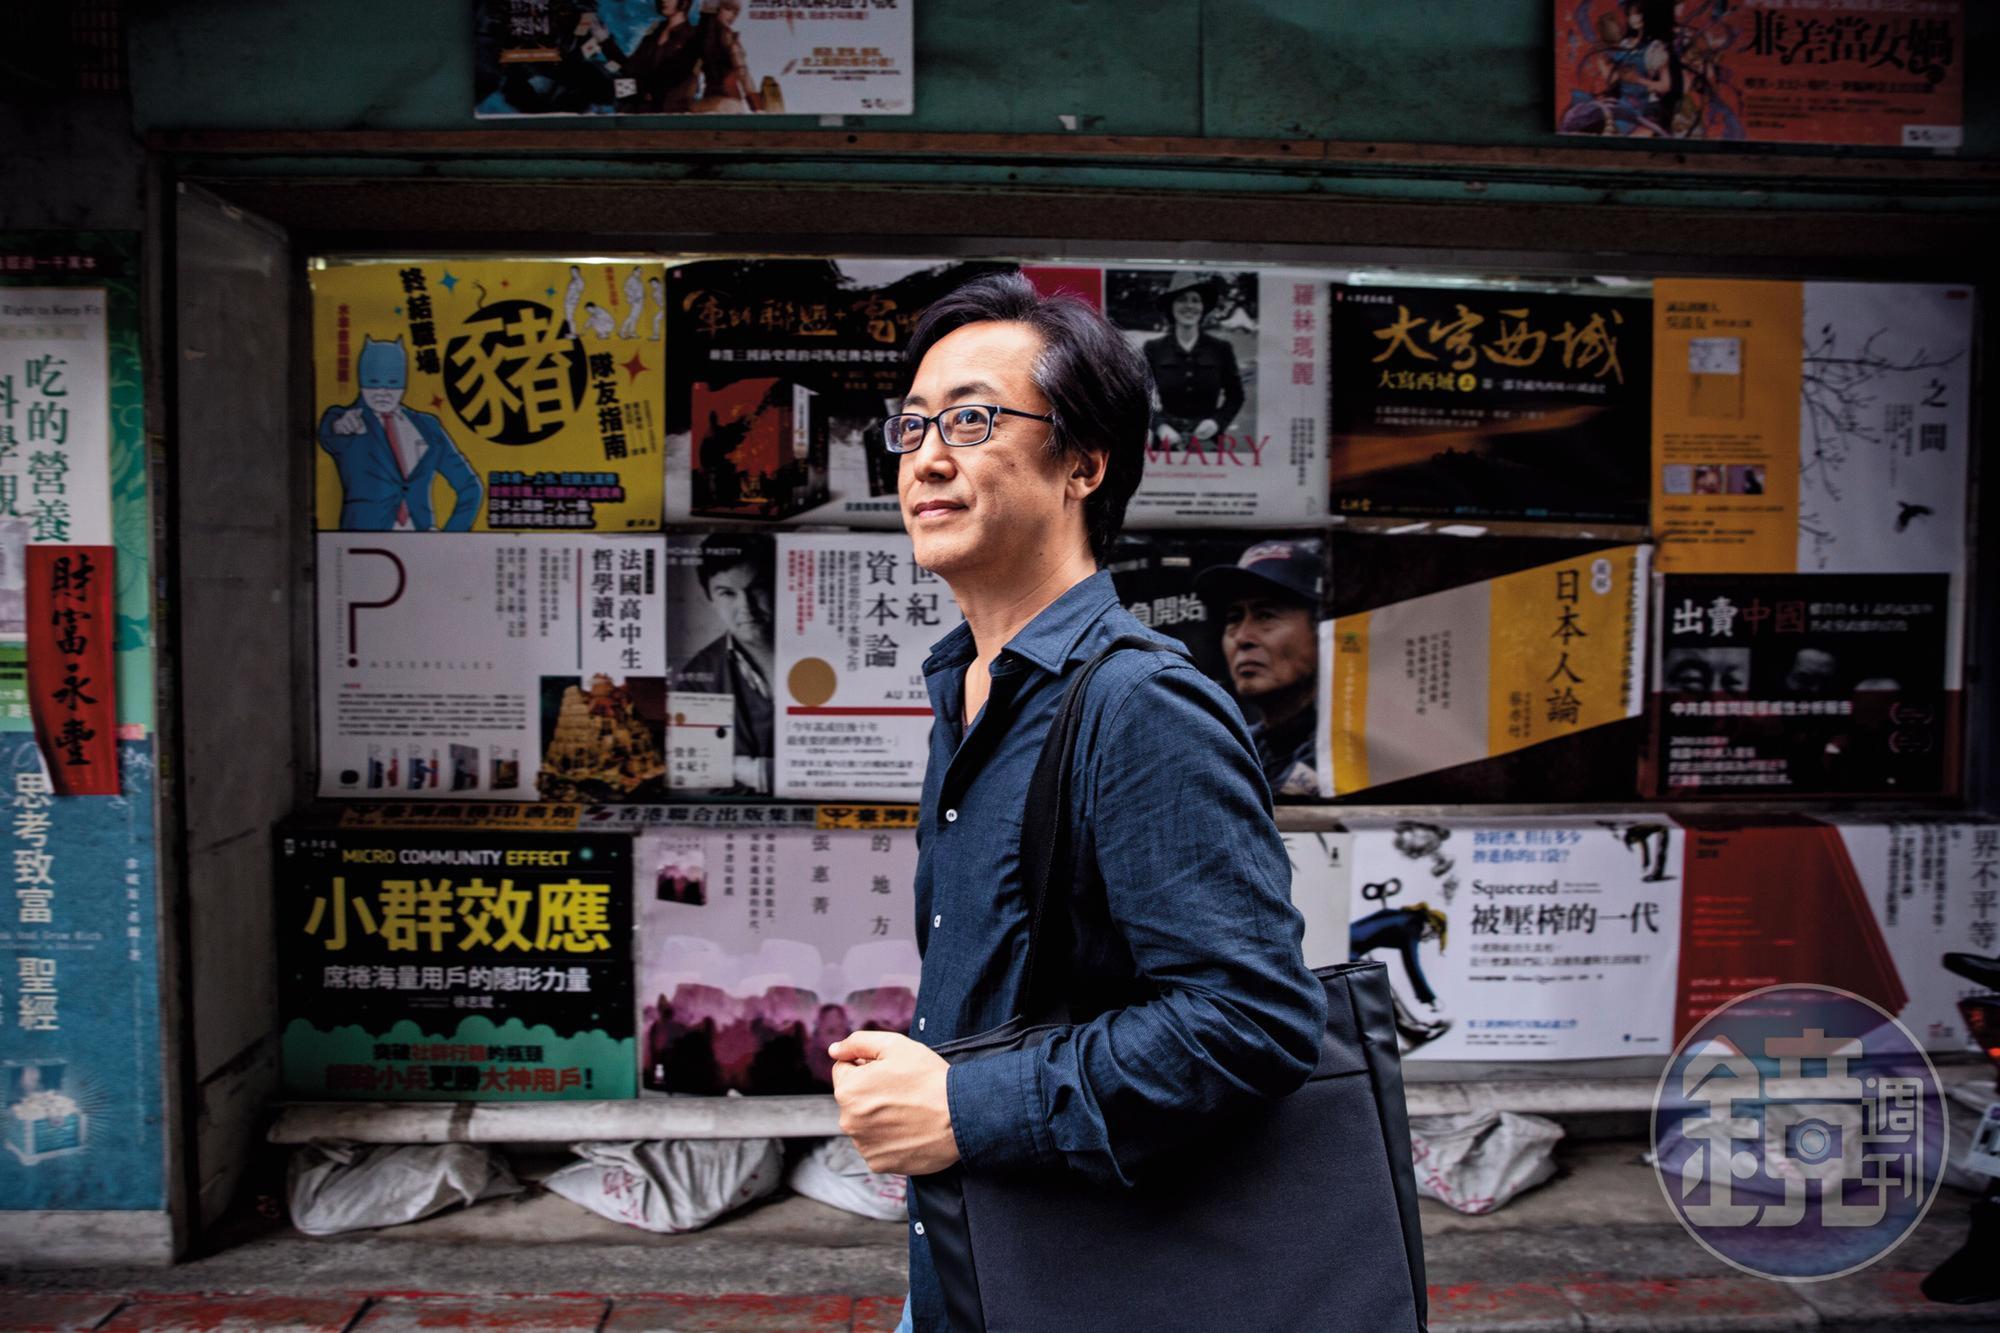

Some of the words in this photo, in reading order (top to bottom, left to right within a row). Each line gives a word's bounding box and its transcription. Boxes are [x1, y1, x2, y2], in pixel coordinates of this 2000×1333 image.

[25, 354, 70, 542] 吃的營養
[590, 352, 628, 461] 隊友指南
[592, 549, 614, 642] 哲學讀本
[620, 549, 642, 669] 法國高中生
[865, 551, 899, 668] 資本論
[1671, 596, 1806, 638] 出賣中國
[1547, 569, 1587, 725] 日本人論
[13, 772, 54, 924] 思考致富
[342, 849, 396, 864] MICRO
[400, 850, 502, 865] COMMUNITY
[505, 850, 571, 866] EFFECT
[619, 806, 814, 822] 香港聯合出版集團
[303, 875, 612, 952] 小群效應
[871, 834, 892, 936] 的地方
[1471, 903, 1660, 935] 被壓榨的一代
[1472, 880, 1558, 900] Squeezed
[1969, 829, 1999, 950] 界不平等
[16, 956, 61, 1031] 聖經
[323, 965, 592, 992] 席捲海量用戶的隱形力量
